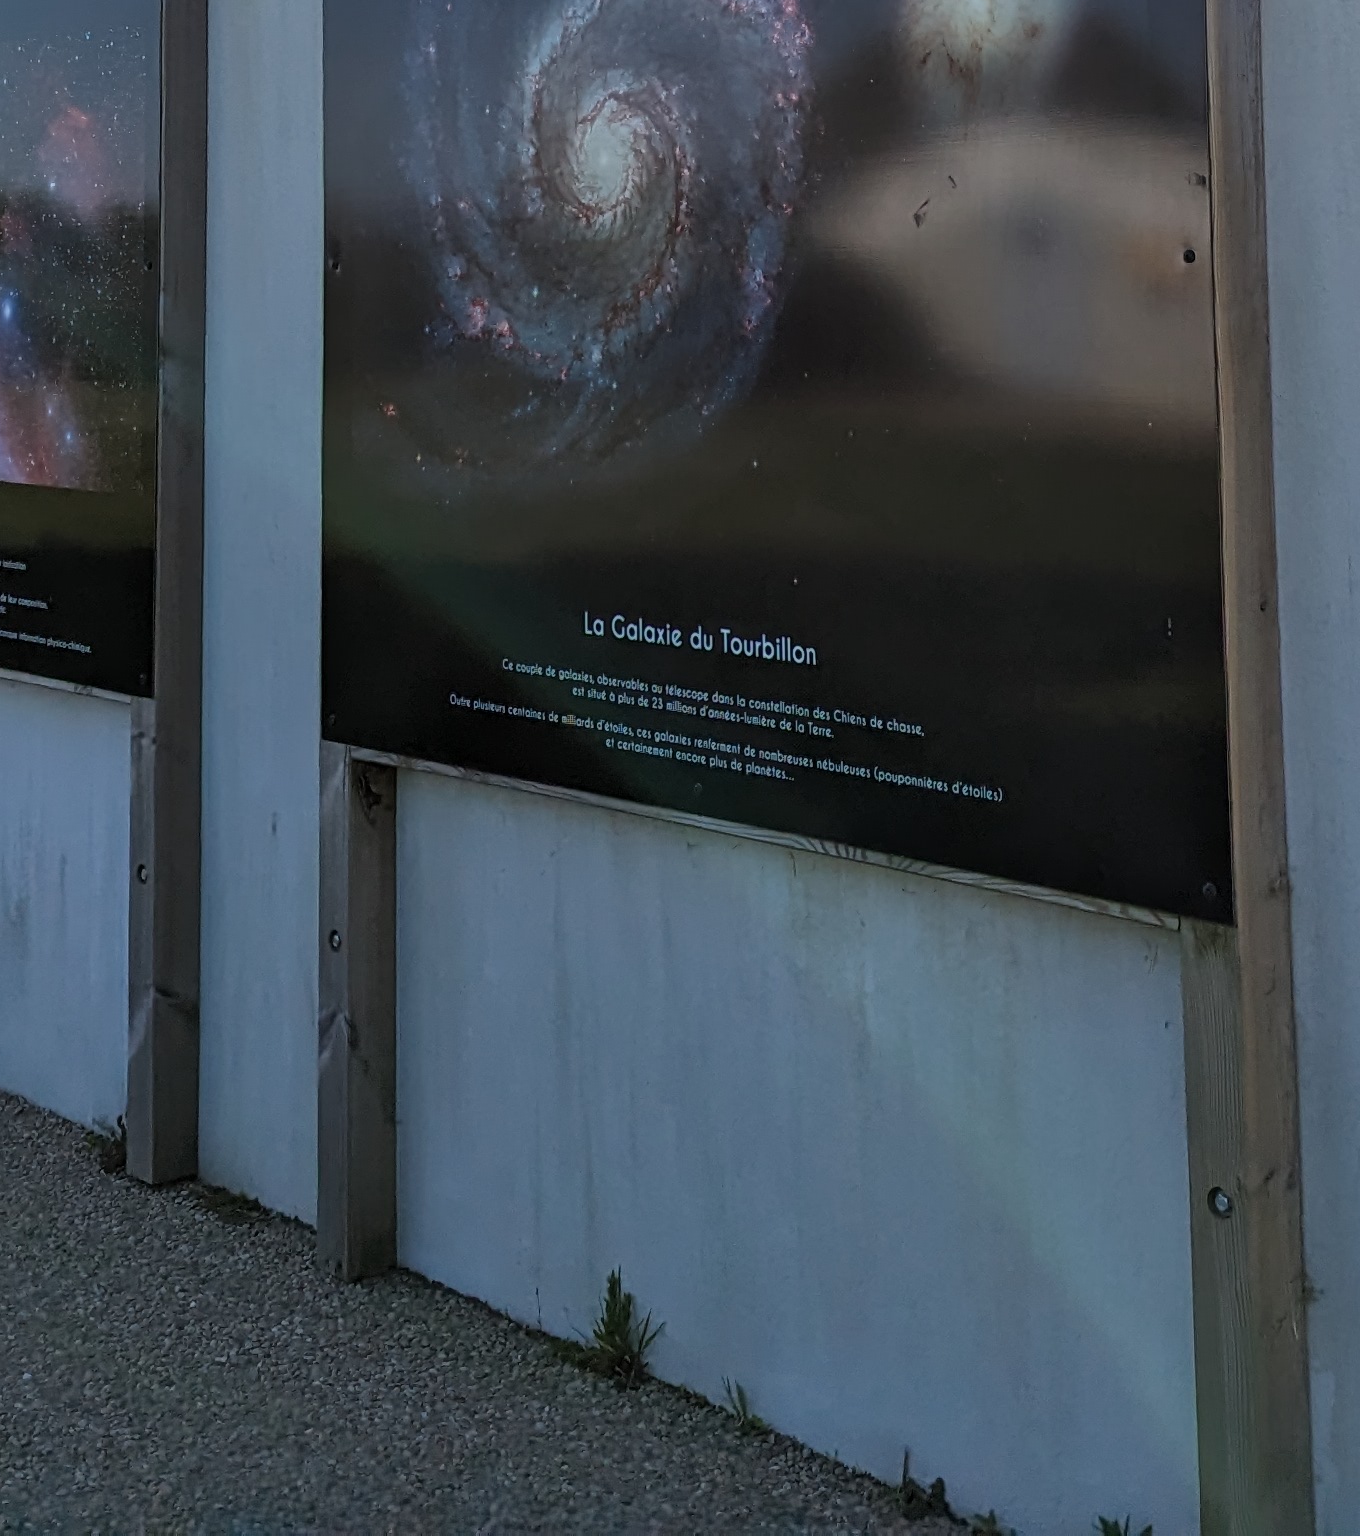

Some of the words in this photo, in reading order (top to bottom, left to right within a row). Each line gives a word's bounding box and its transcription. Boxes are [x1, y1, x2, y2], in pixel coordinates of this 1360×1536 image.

[584, 611, 604, 636] La
[611, 615, 682, 646] Galaxie
[689, 625, 713, 650] du
[720, 628, 816, 664] Tourbillon
[502, 658, 513, 670] Ce
[515, 663, 543, 675] couple
[545, 664, 556, 677] de
[558, 668, 594, 684] galaxies,
[596, 673, 648, 692] observables
[651, 684, 662, 698] au
[665, 684, 708, 701] télescope
[711, 690, 734, 705] dans
[736, 694, 745, 707] la
[748, 699, 809, 716] constellation
[812, 706, 830, 720] des
[833, 709, 866, 726] Chiens
[869, 715, 883, 729] de
[572, 686, 584, 696] est
[587, 688, 606, 700] situé
[617, 692, 634, 704] plus
[637, 694, 649, 707] de
[651, 696, 663, 709] 23
[779, 718, 792, 730] de
[795, 719, 804, 732] la
[449, 693, 470, 707] Outre
[473, 698, 505, 713] plusieurs
[507, 706, 545, 720] centaines
[548, 710, 558, 722] de
[596, 719, 634, 736] d'étoiles,
[636, 728, 651, 739] ces
[653, 730, 691, 745] galaxies
[693, 738, 740, 753] renferment
[743, 744, 756, 757] de
[758, 749, 813, 767] nombreuses
[816, 758, 870, 777] nébuleuses
[951, 781, 1002, 801] d'étoiles)
[605, 737, 614, 747] et
[616, 740, 673, 758] certainement
[675, 750, 706, 764] encore
[709, 754, 727, 768] plus
[730, 758, 742, 771] de
